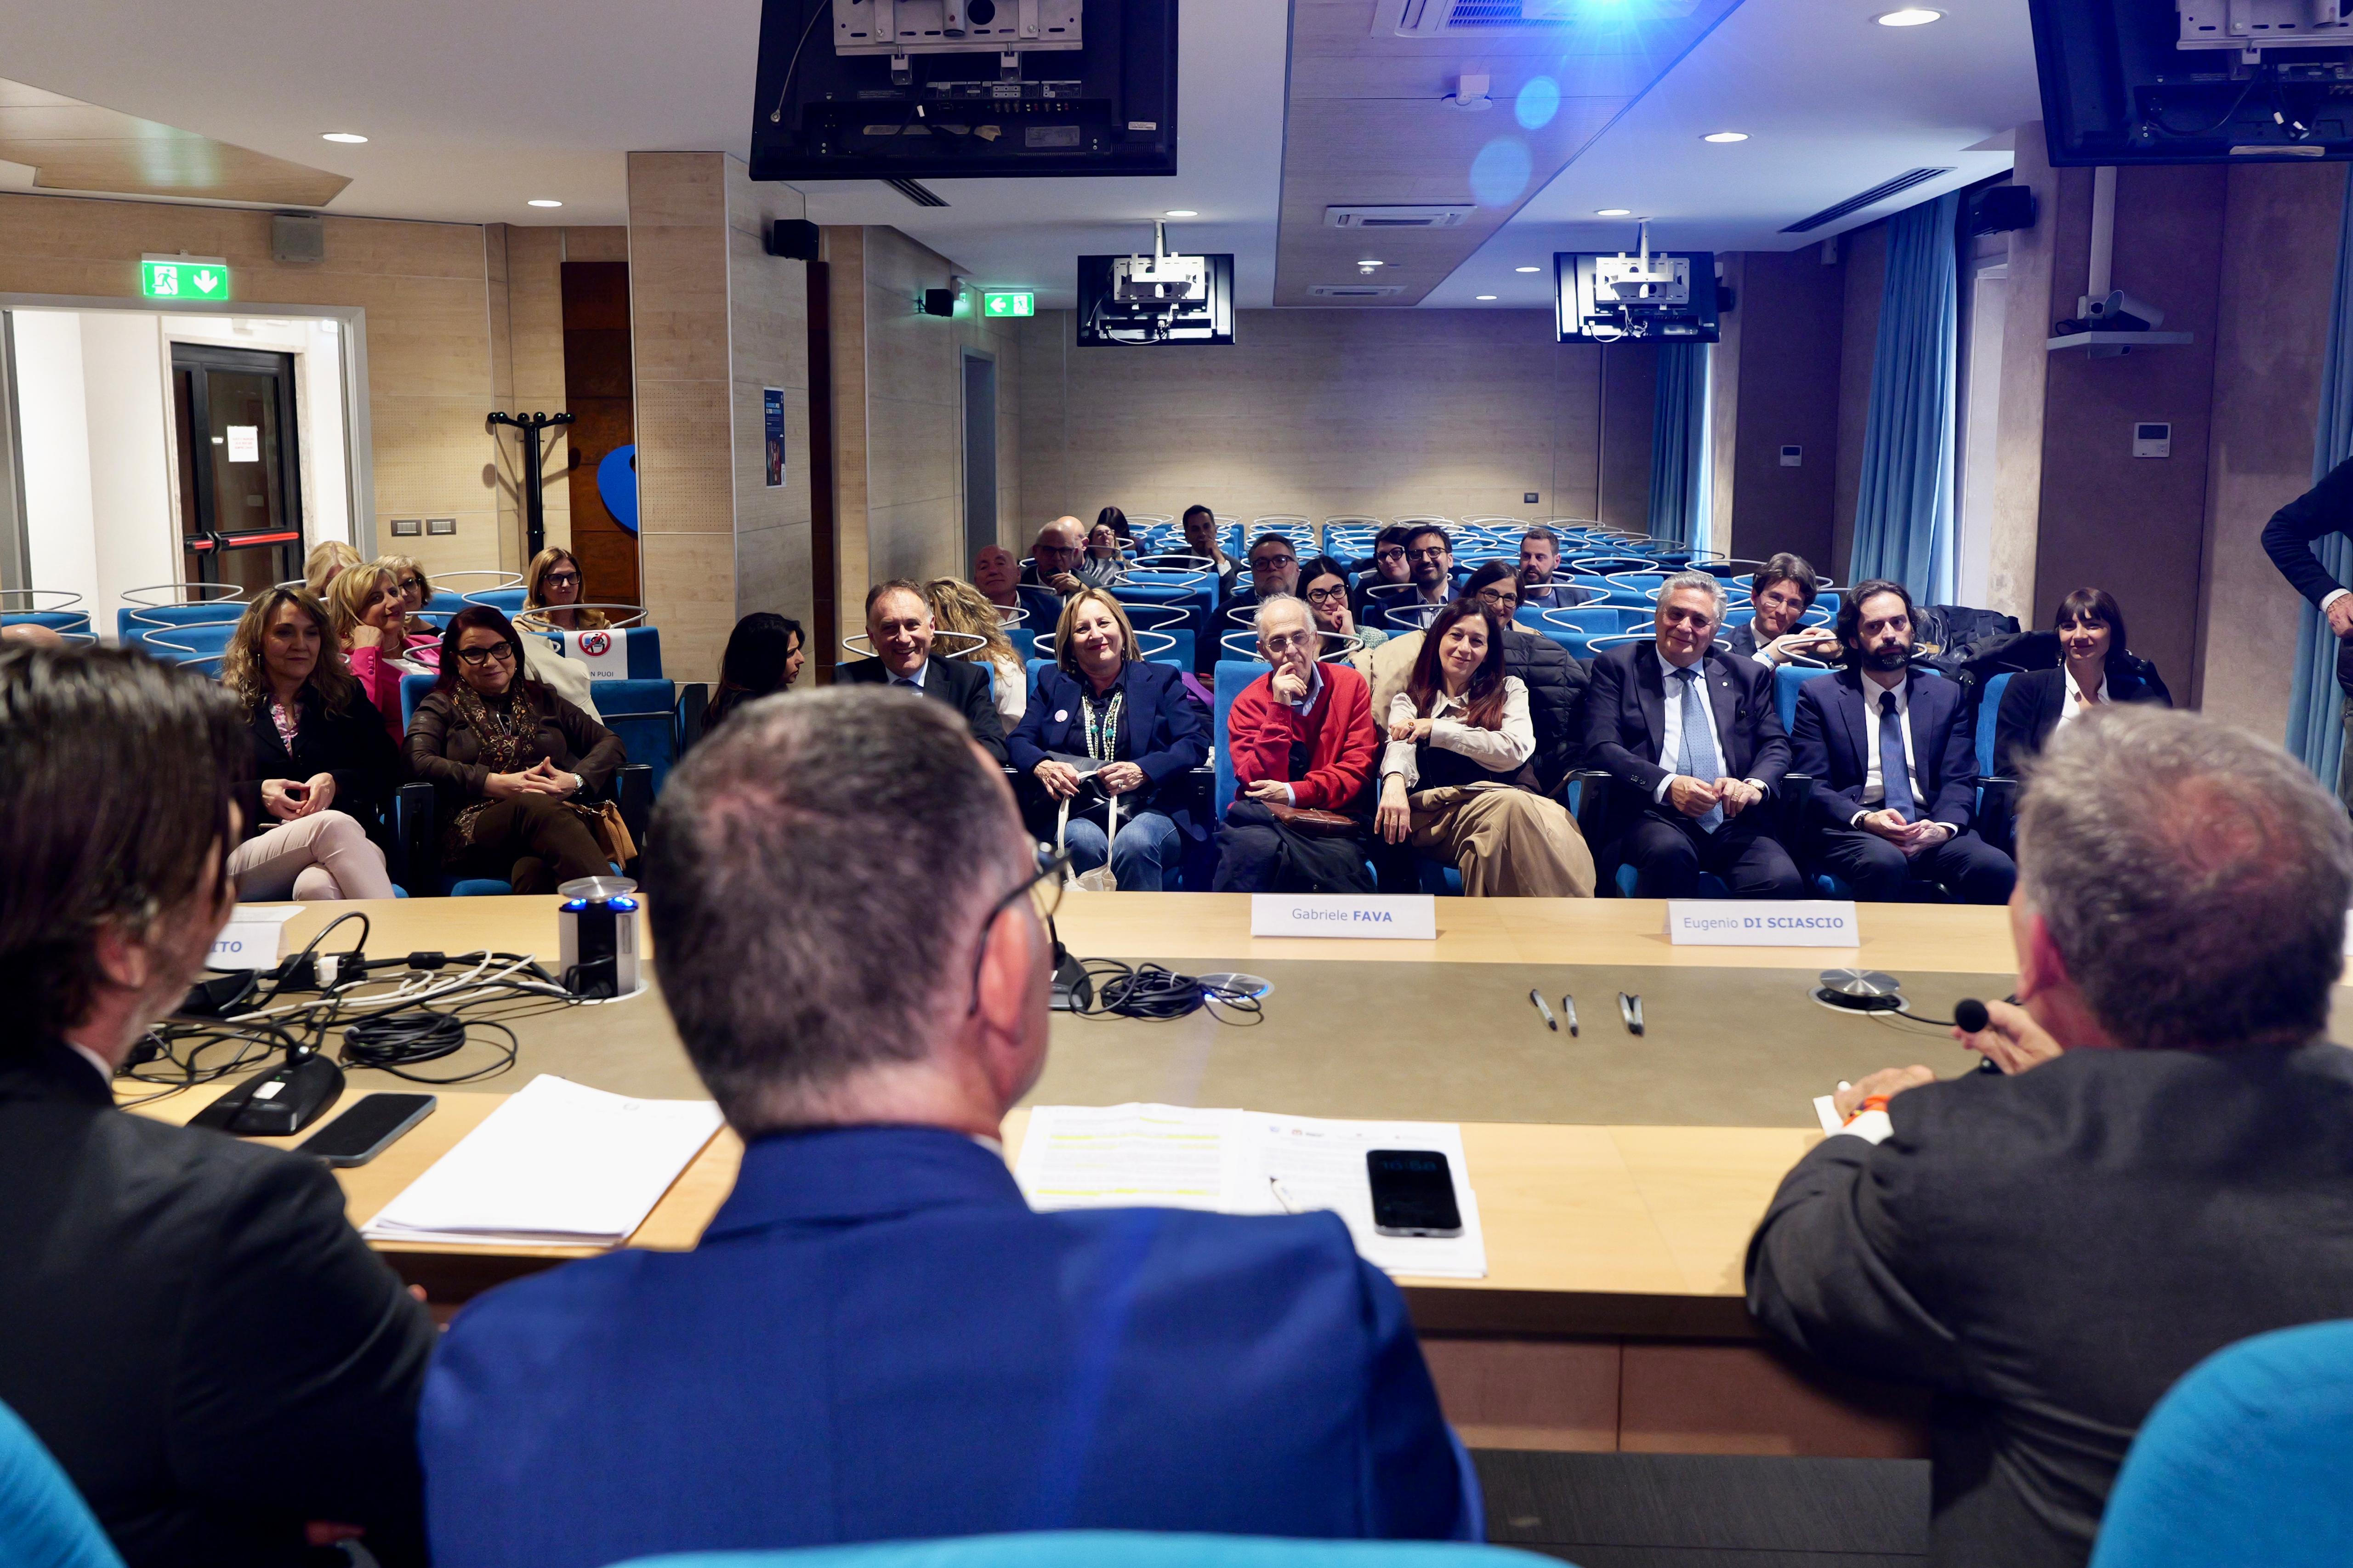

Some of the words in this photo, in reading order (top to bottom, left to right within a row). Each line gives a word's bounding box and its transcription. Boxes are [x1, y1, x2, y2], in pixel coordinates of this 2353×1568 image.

[1292, 908, 1348, 921] Gabriele
[1353, 910, 1393, 922] FAVA
[1683, 917, 1739, 931] Eugenio
[1743, 917, 1762, 928] DI
[1768, 917, 1844, 928] SCIASCIO
